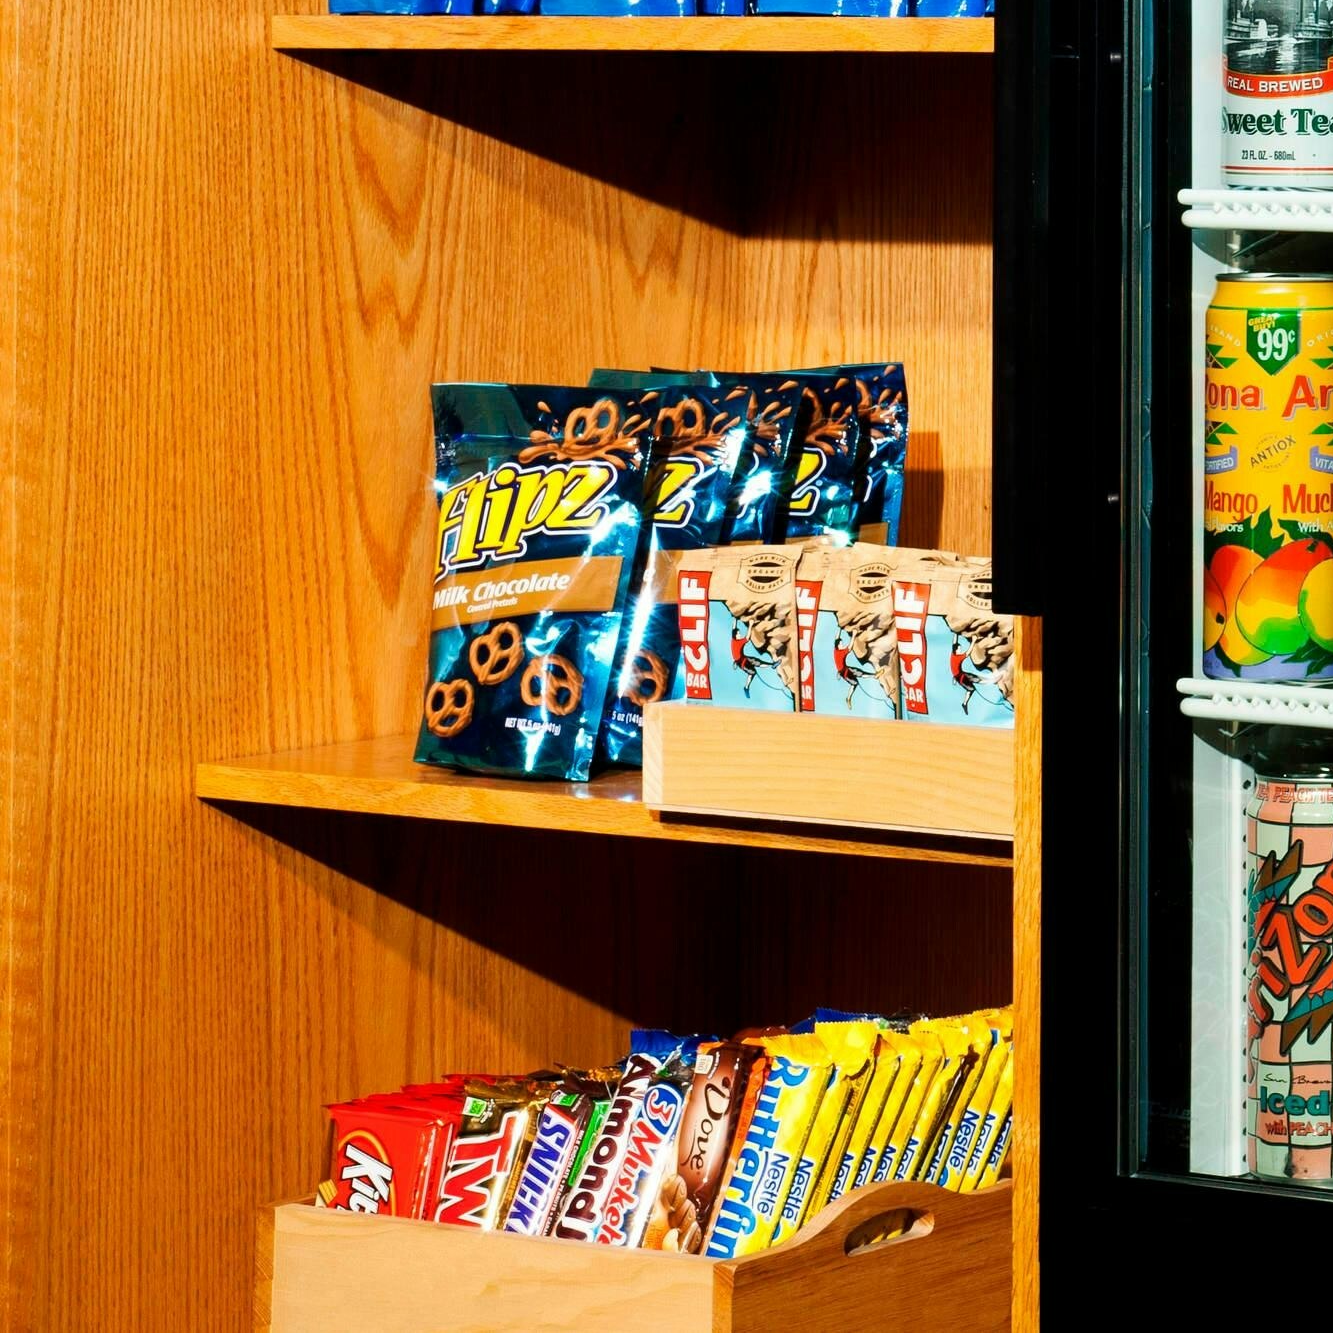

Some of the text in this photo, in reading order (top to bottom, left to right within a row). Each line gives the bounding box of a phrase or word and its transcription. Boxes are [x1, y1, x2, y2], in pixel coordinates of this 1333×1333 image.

[1227, 76, 1323, 92] REAL BREWED
[1257, 328, 1295, 361] 99¢
[434, 461, 617, 583] Flipz
[433, 571, 571, 611] Milk Chocolate
[681, 576, 708, 672] CLIF
[1260, 1085, 1329, 1116] Iced
